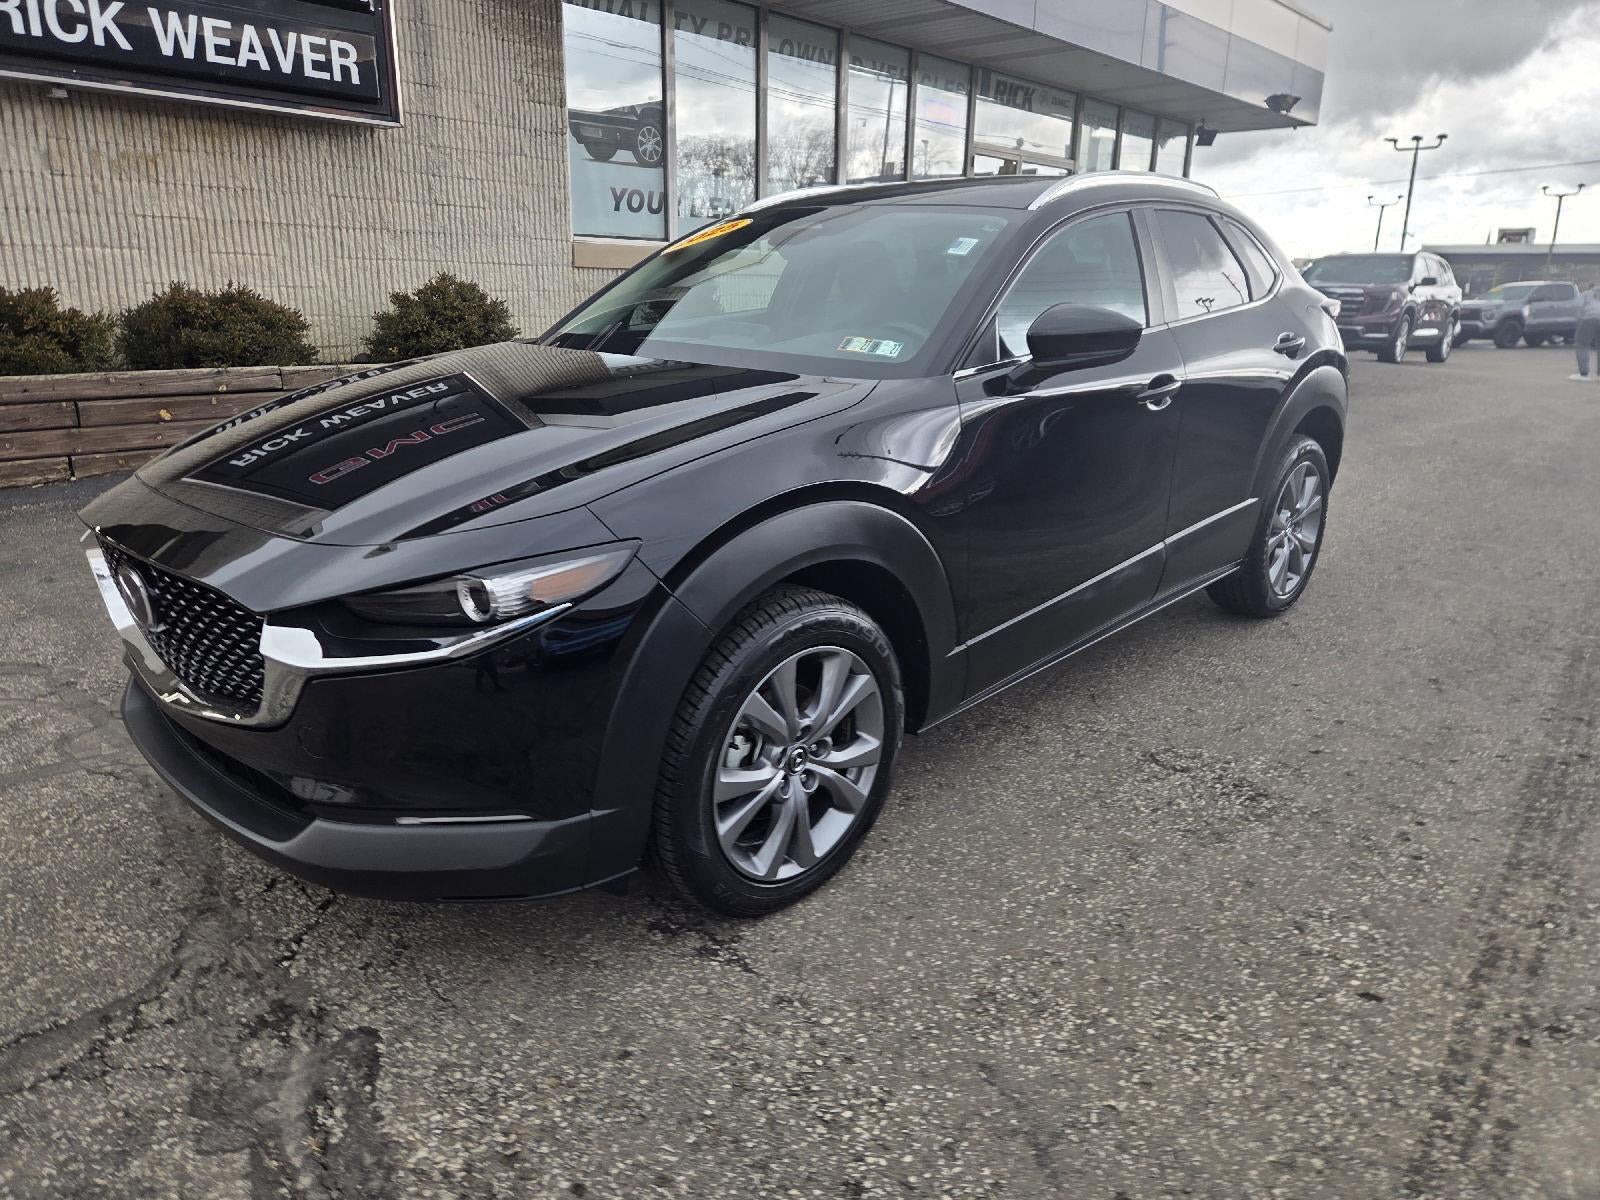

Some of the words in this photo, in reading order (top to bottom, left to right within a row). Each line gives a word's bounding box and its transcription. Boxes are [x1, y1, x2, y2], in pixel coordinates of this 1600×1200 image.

[0, 0, 133, 50] RICK
[147, 7, 360, 85] WEAVER
[610, 186, 682, 217] YOU
